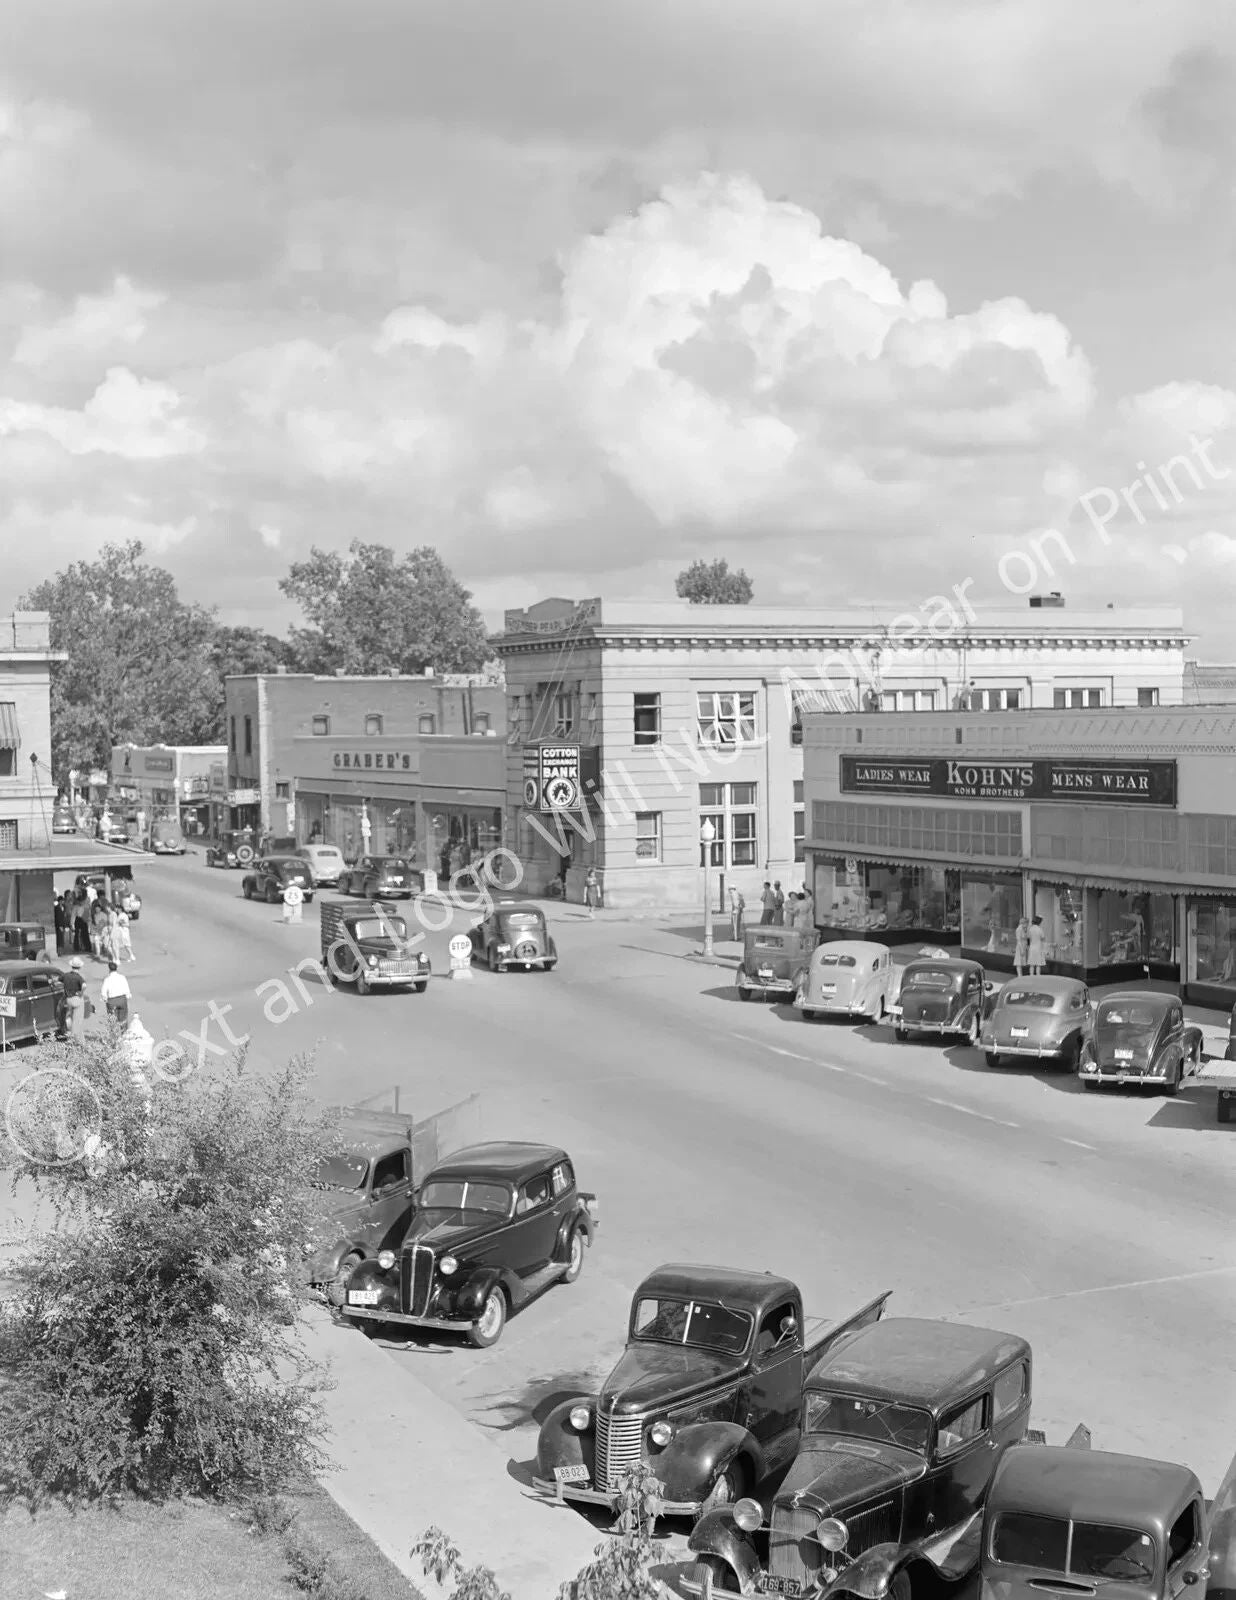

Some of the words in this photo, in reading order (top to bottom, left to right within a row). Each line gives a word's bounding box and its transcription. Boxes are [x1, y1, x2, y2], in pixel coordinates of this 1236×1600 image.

[542, 748, 577, 758] COTTON
[333, 752, 410, 769] GRABER'S
[542, 766, 577, 778] BANK
[855, 768, 894, 781] LADIES
[898, 769, 931, 783] WEAR
[946, 761, 1034, 787] KOHN'S
[1051, 773, 1093, 787] MENS
[1102, 775, 1149, 790] WEAR
[954, 787, 977, 796] KOHN
[980, 788, 1025, 797] BROTHERS
[451, 941, 470, 950] STOP
